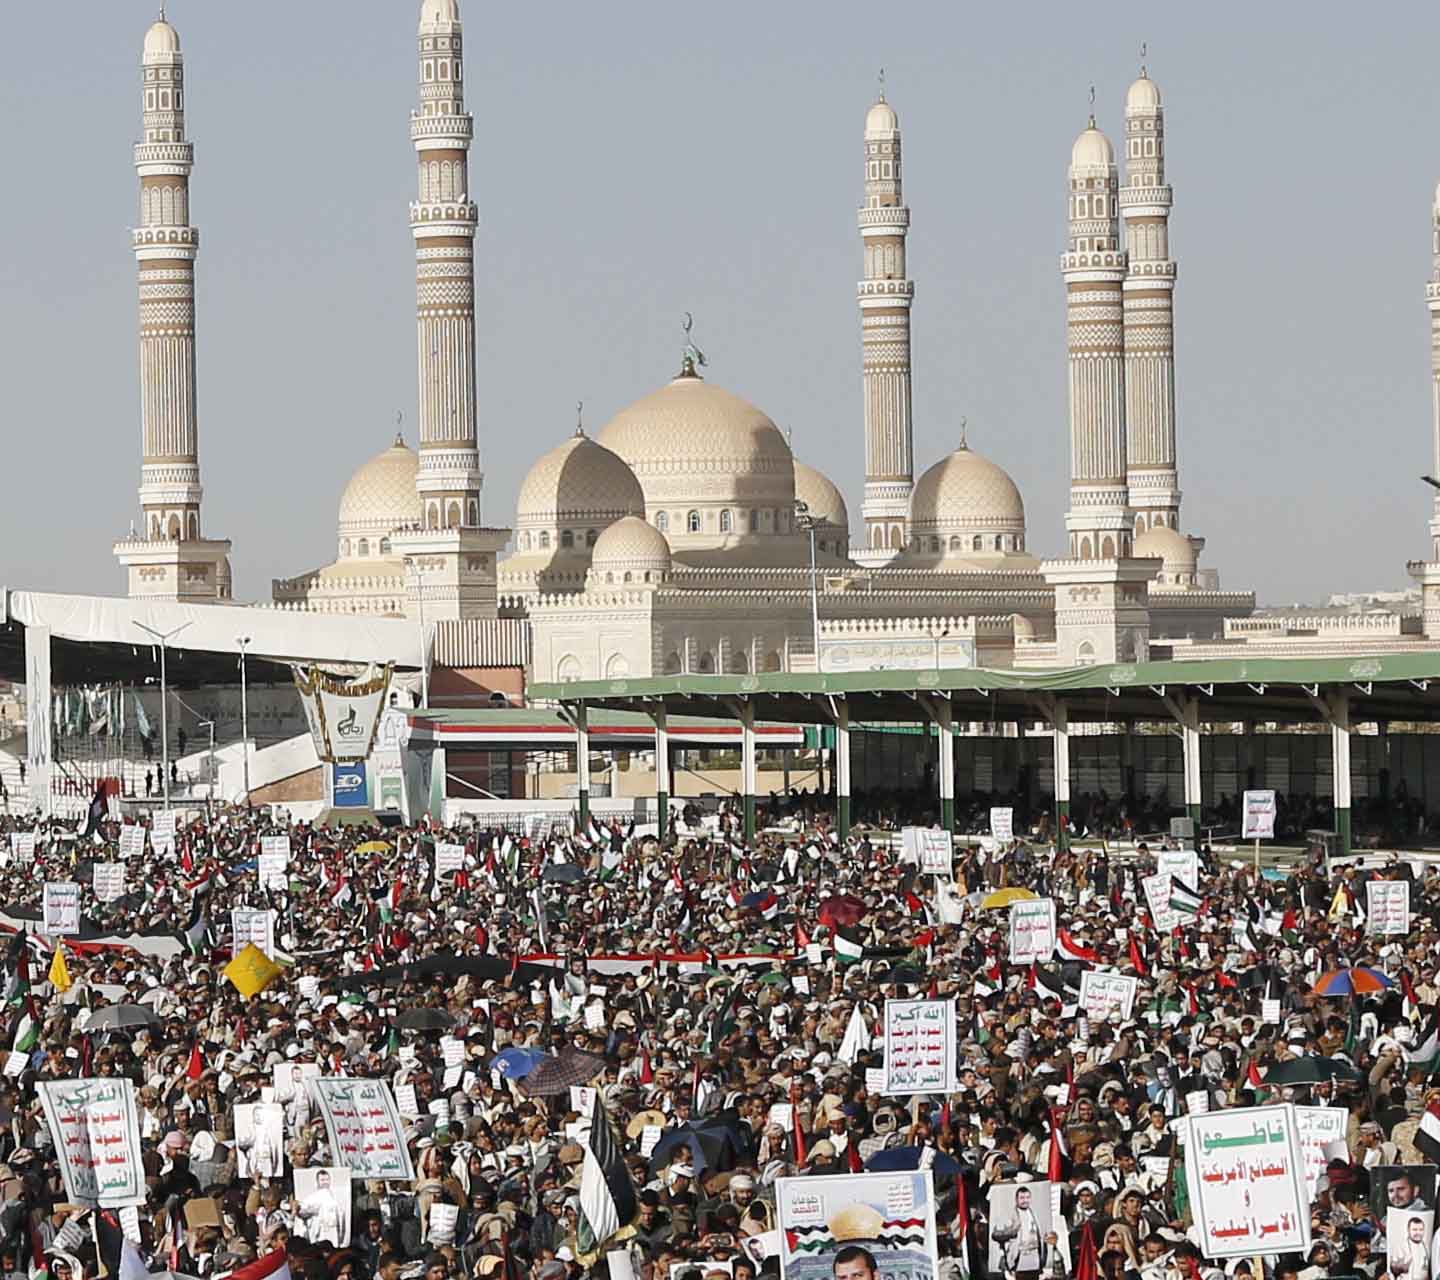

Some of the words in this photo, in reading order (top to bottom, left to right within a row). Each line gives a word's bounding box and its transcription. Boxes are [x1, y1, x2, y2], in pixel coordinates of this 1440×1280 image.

[1197, 1120, 1284, 1155] قاطعوا
[1250, 1158, 1287, 1182] البضائع
[1244, 1189, 1250, 1207] و
